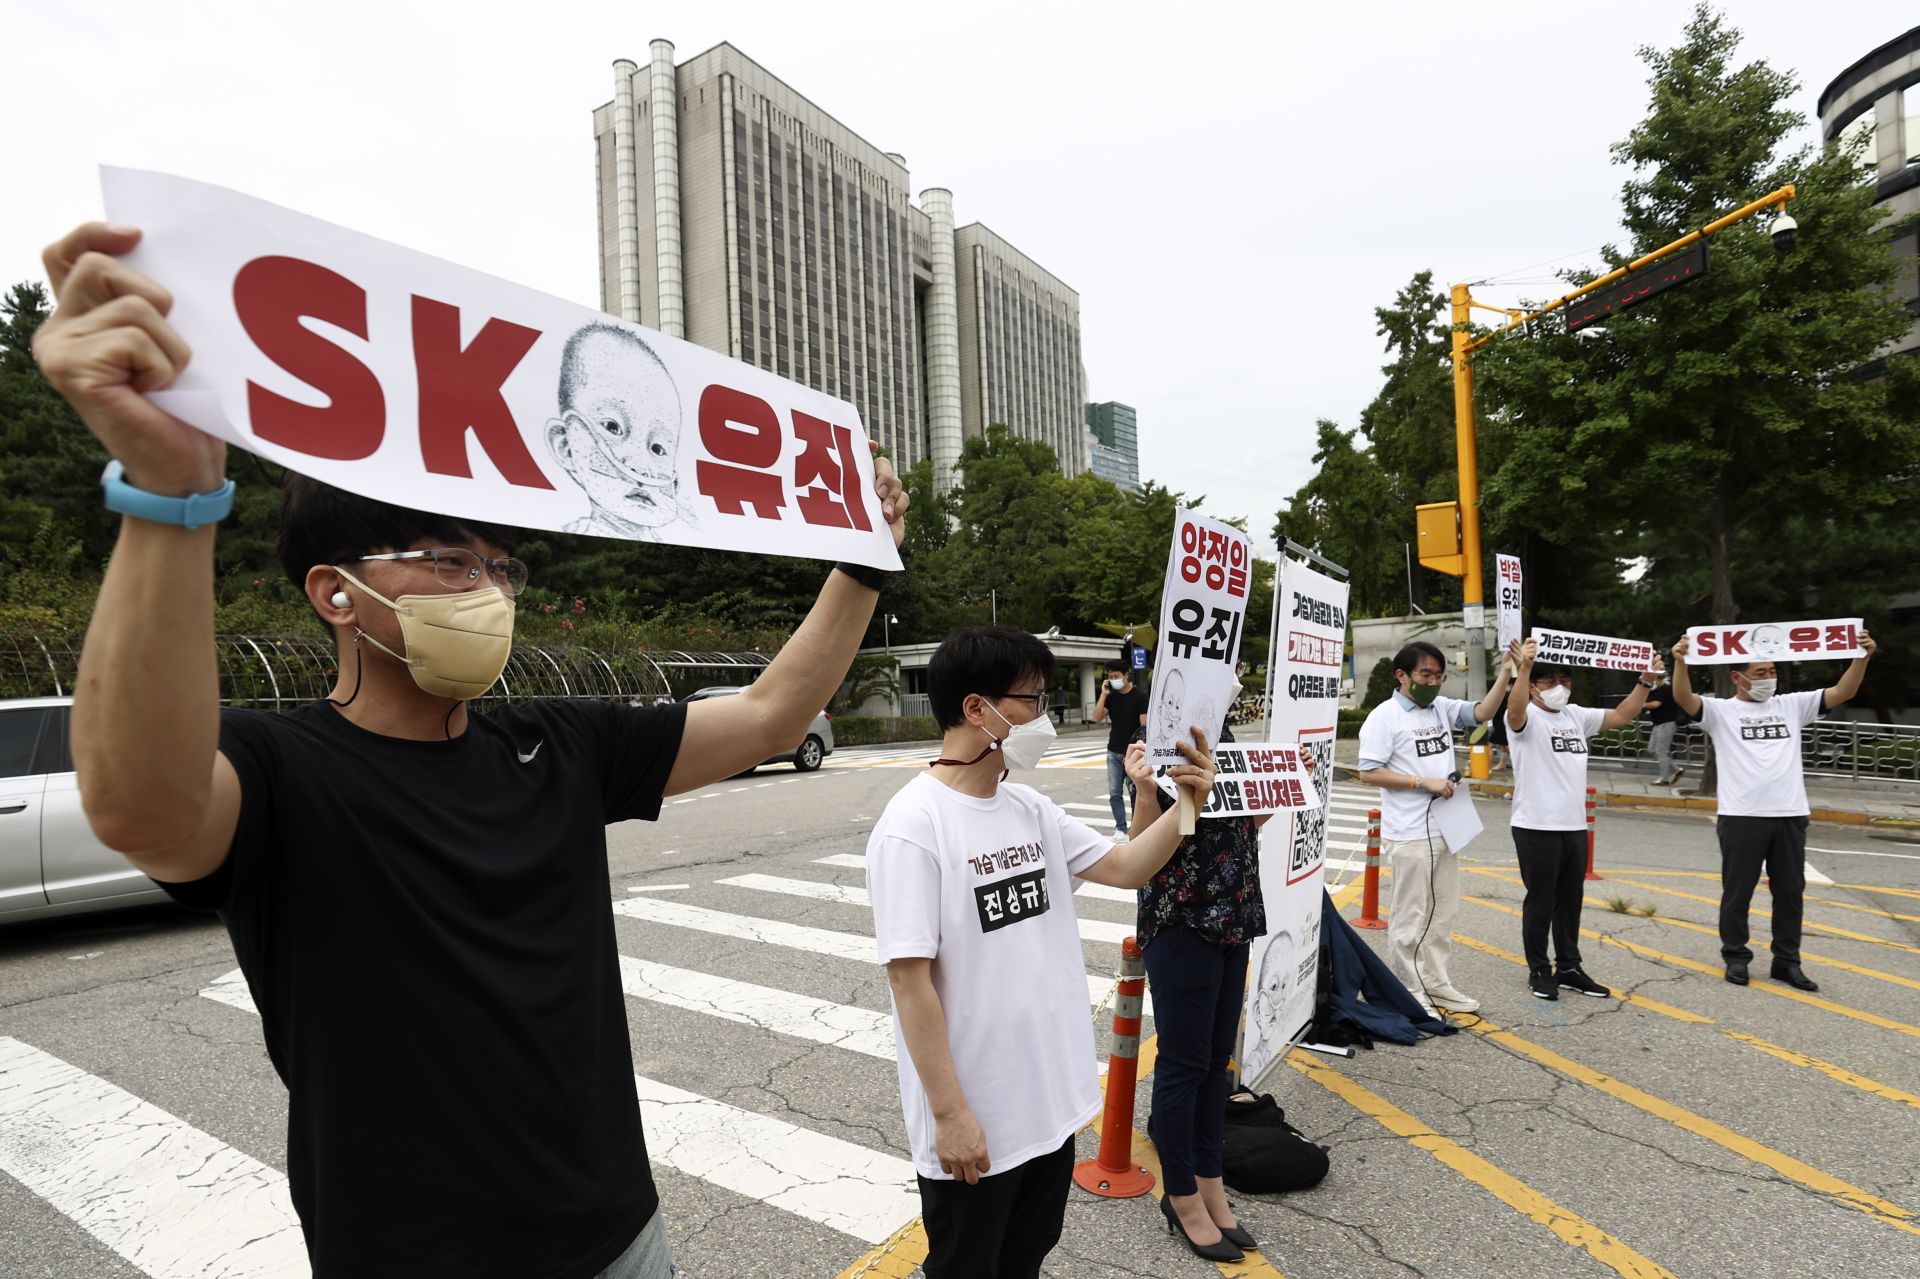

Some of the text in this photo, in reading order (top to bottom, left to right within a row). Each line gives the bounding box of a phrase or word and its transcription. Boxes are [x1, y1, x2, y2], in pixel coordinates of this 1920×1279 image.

[233, 255, 872, 533] SK 유죄
[1181, 521, 1248, 597] 양정일
[1499, 559, 1521, 583] 박철
[1502, 587, 1521, 610] 유죄
[1168, 599, 1240, 664] 유죄
[1539, 633, 1652, 660] 가습기살균제 진상규명
[1696, 624, 1858, 656] SK 유죄
[1288, 673, 1325, 702] QR코드로
[1743, 726, 1789, 738] 진상규명
[1247, 750, 1297, 773] 진상규명
[1243, 779, 1307, 810] 형사처벌
[968, 845, 1028, 876] 가습기살균제
